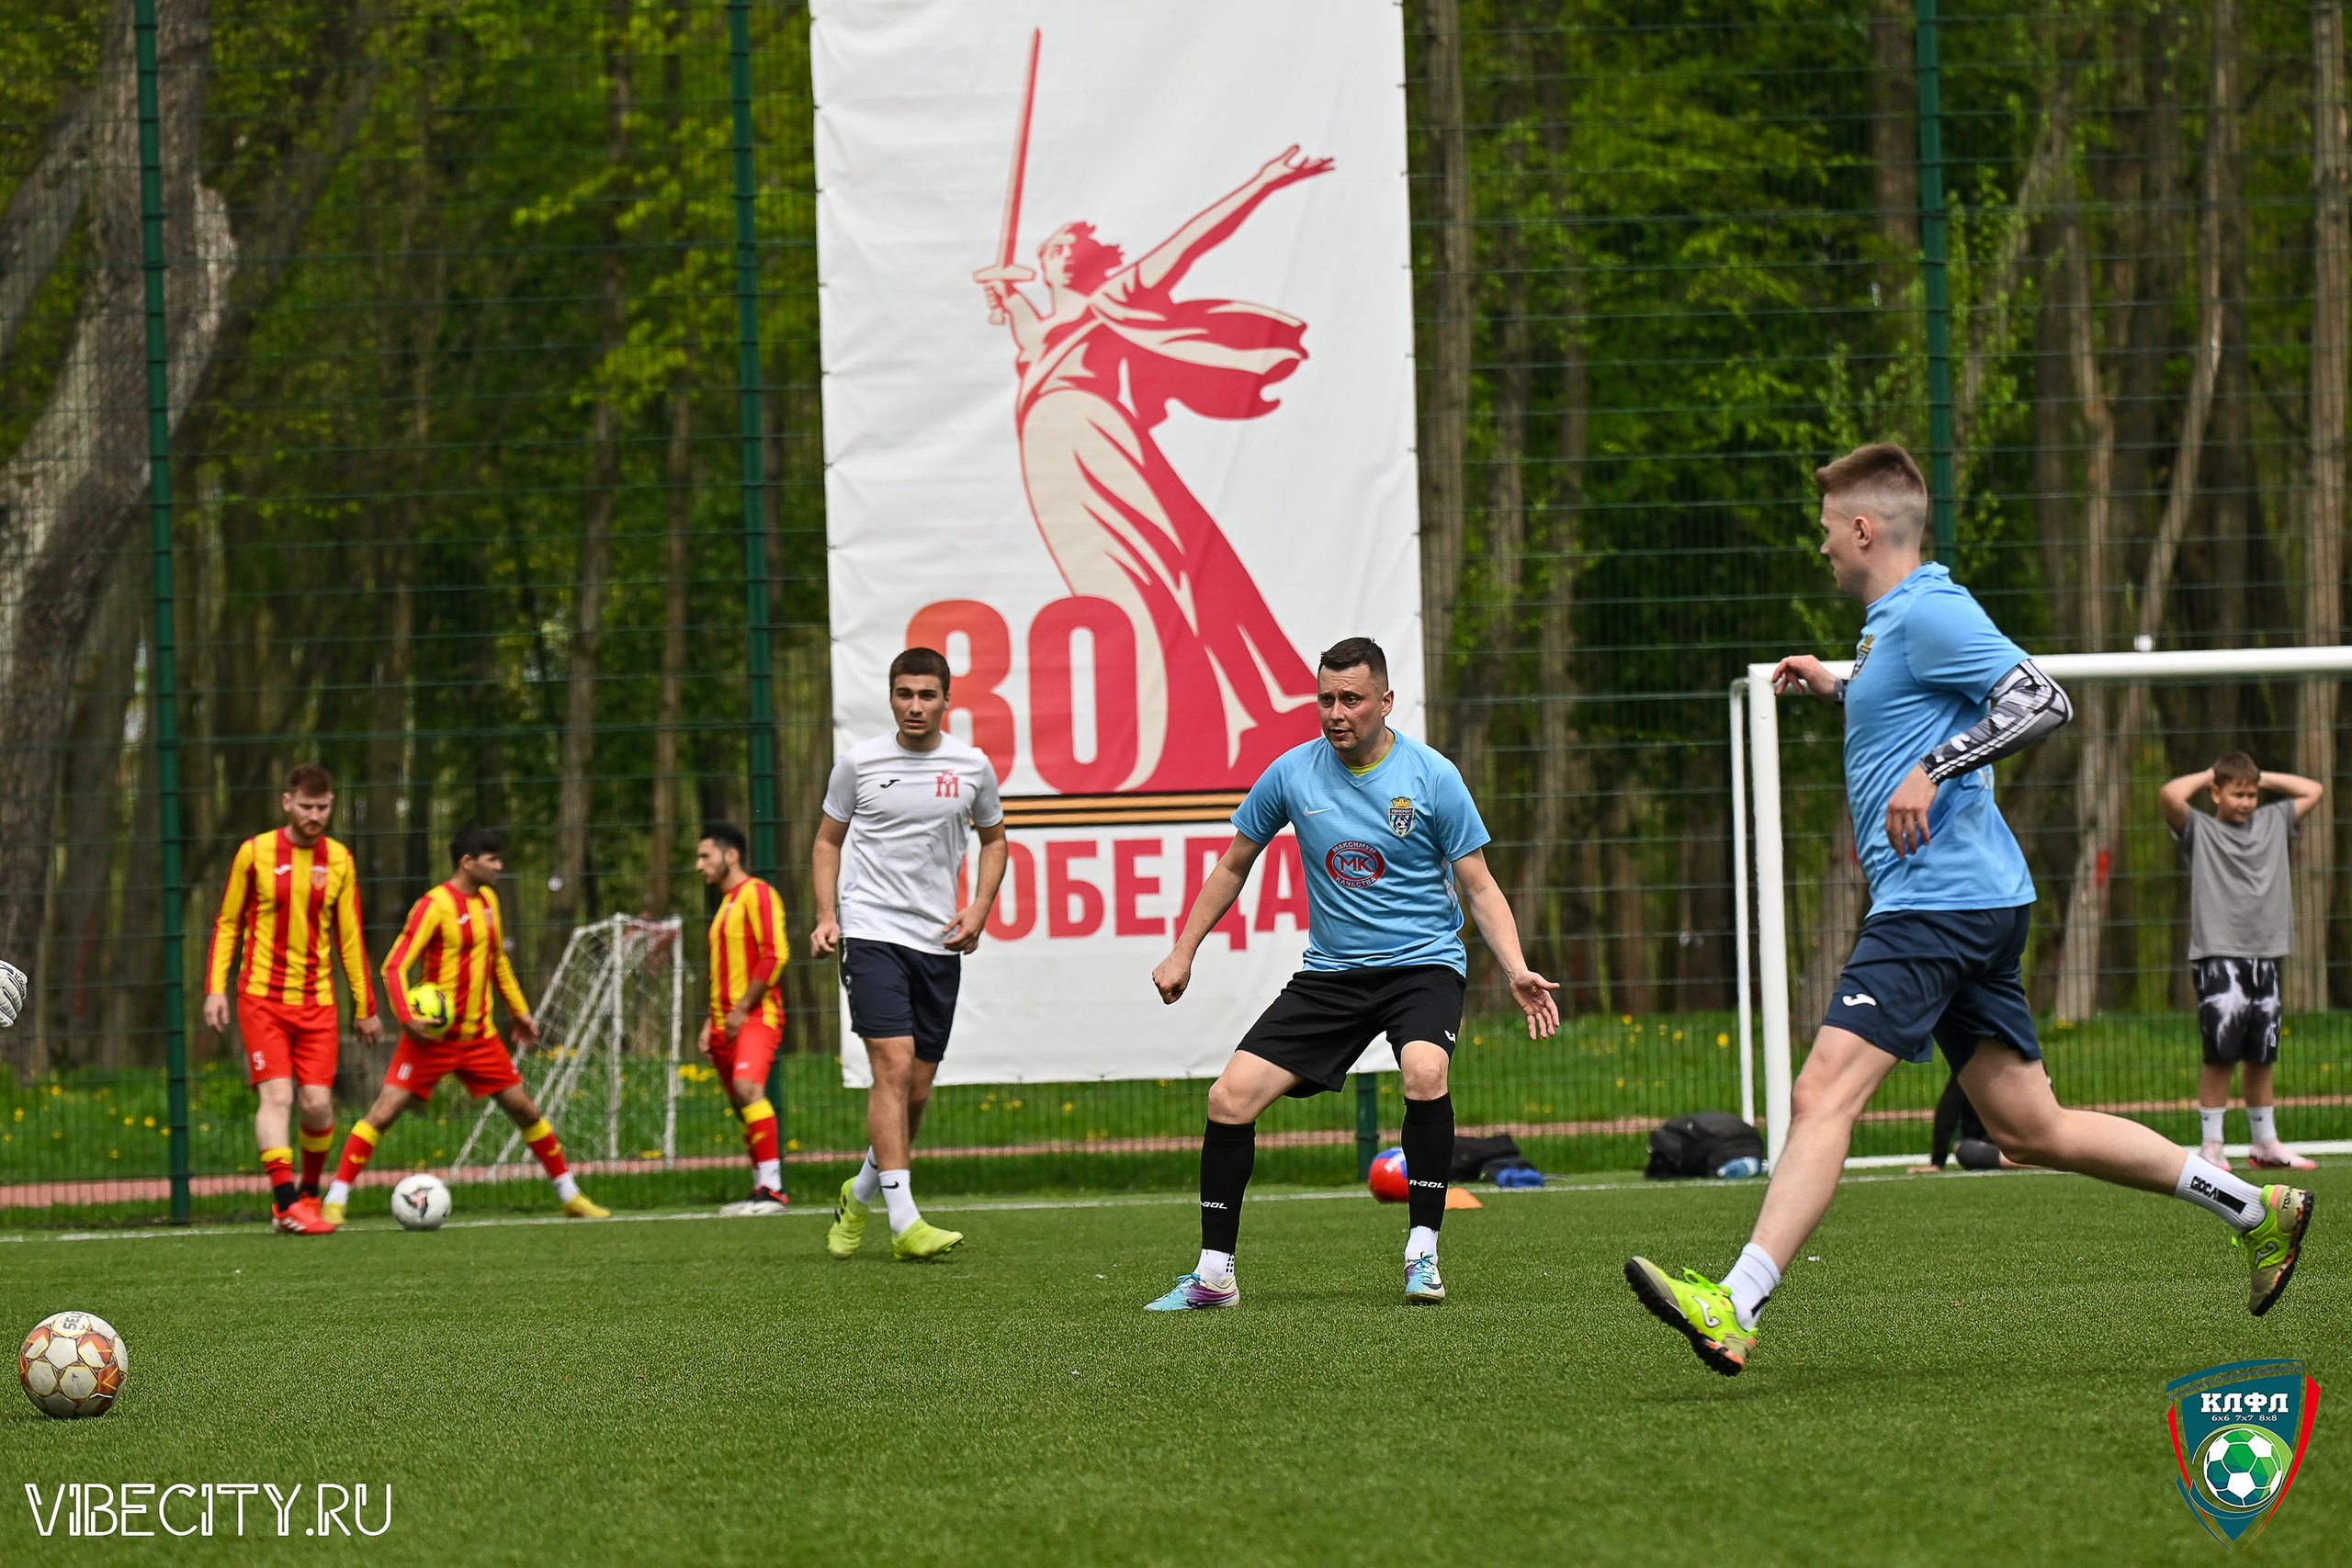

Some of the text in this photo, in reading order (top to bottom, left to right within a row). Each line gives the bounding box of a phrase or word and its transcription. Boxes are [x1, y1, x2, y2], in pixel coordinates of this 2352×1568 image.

[905, 595, 1140, 795] 80
[1332, 841, 1376, 855] МАКСИМУМ
[956, 834, 1309, 952] ОБЕДА
[1335, 876, 1376, 887] КАЧЕСТВА
